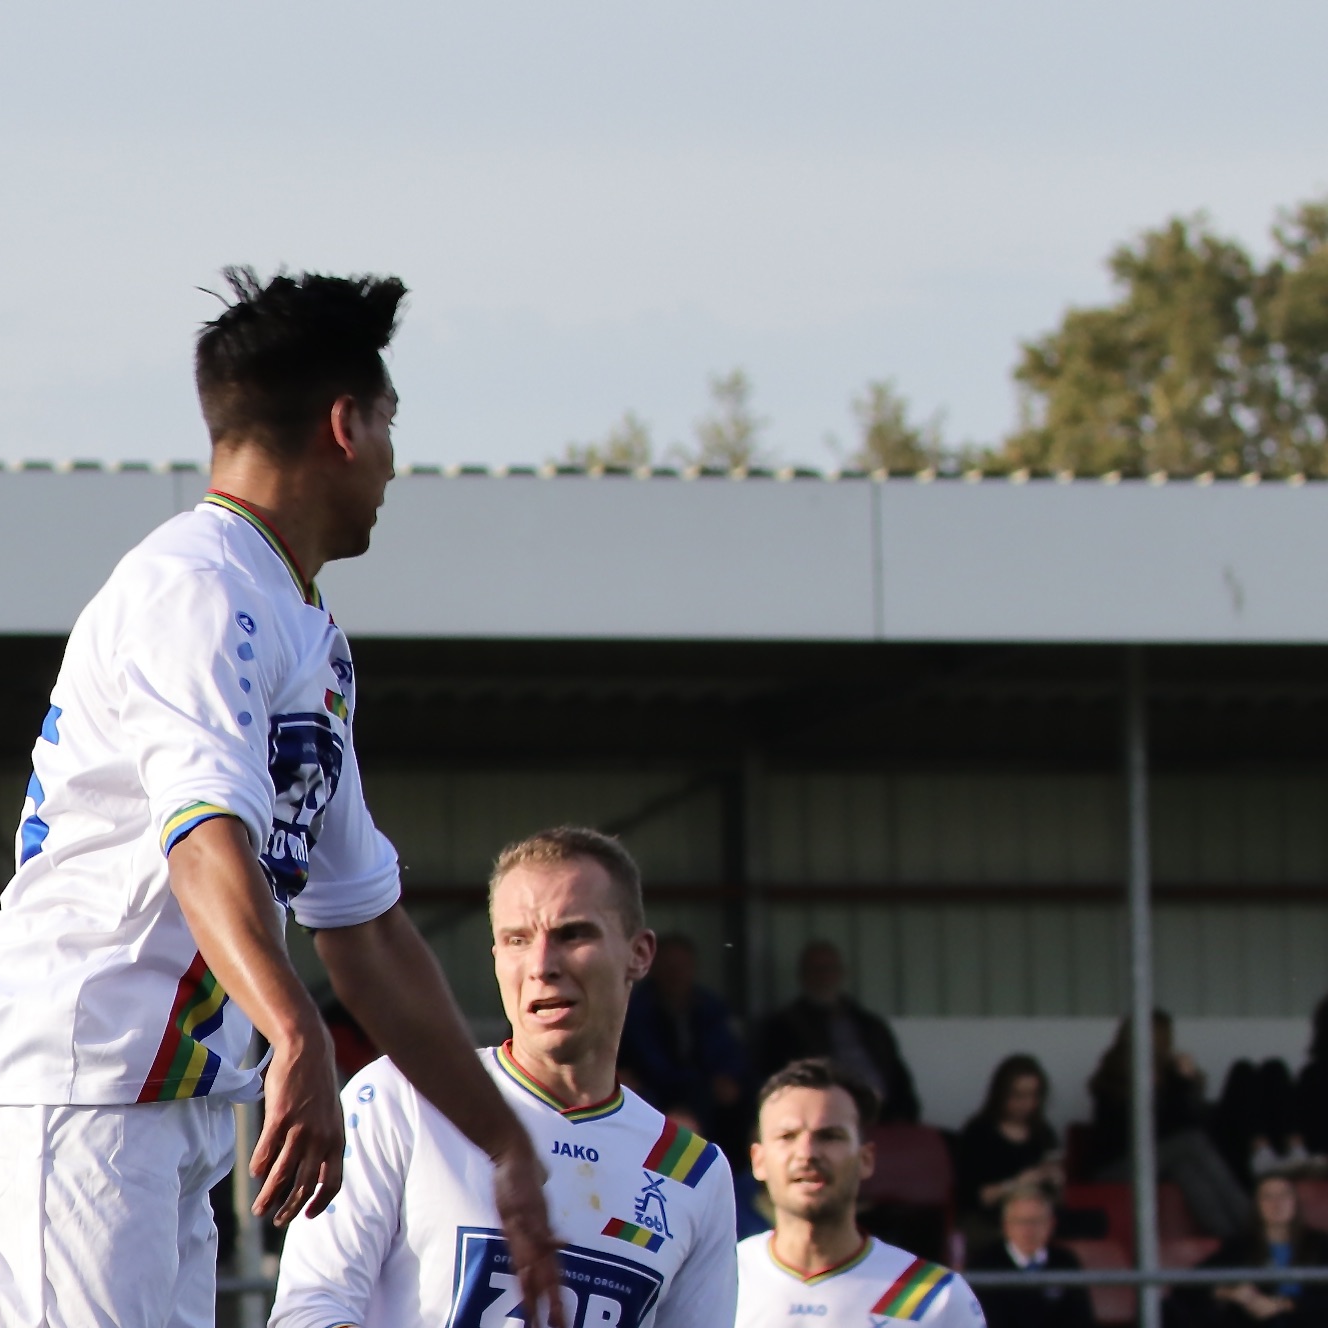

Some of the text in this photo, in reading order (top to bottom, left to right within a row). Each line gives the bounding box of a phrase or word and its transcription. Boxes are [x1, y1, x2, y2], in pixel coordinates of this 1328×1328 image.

[551, 1141, 599, 1162] JAKO
[593, 1277, 632, 1294] ORGAAN
[789, 1304, 827, 1316] JAKO
